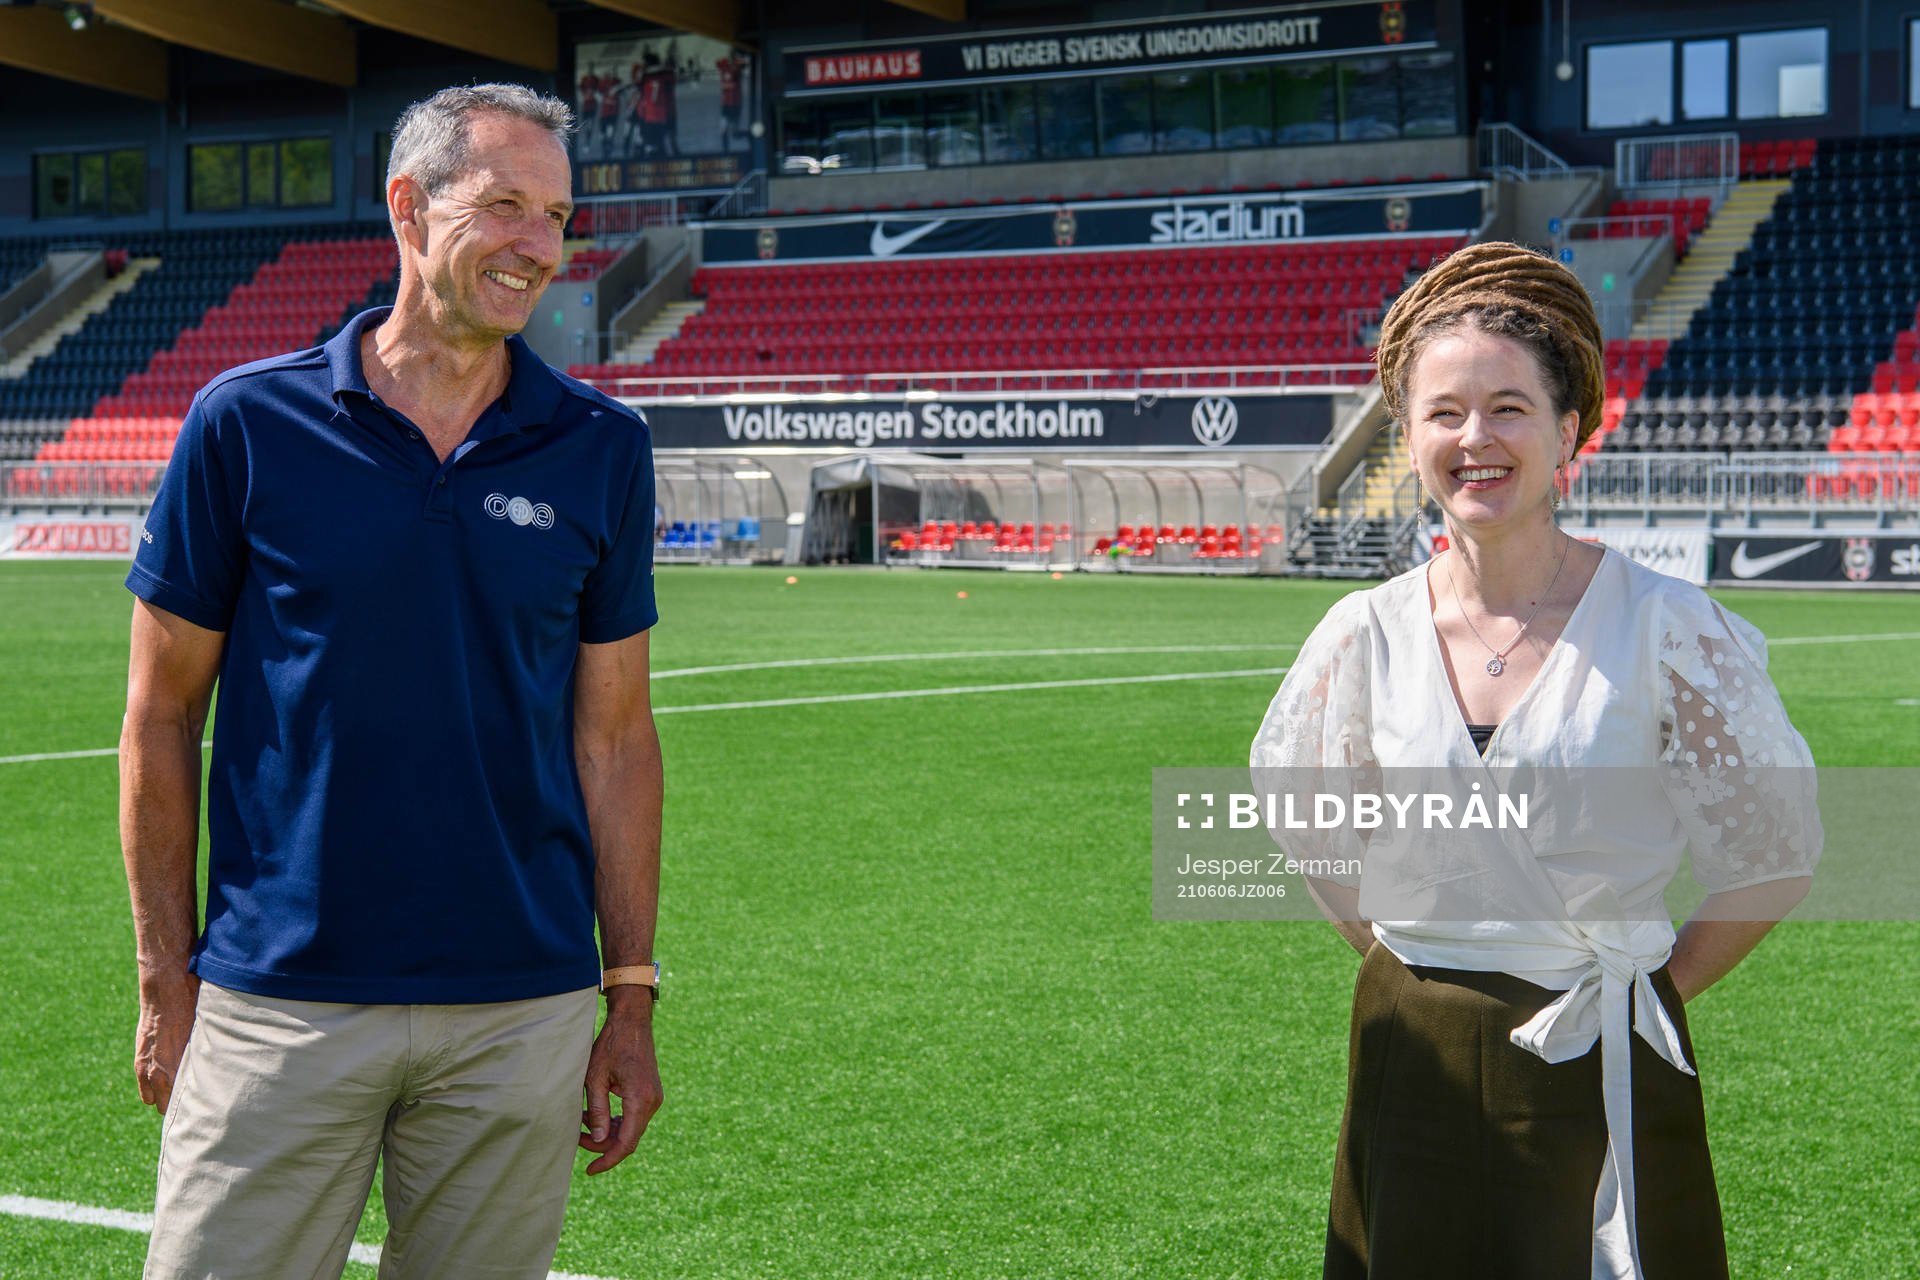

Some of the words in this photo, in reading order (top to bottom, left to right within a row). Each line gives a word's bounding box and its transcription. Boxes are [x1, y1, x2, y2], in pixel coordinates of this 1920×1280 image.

[961, 46, 983, 71] VI
[986, 39, 1060, 69] BYGGER
[1064, 33, 1144, 64] SVENSK
[1145, 17, 1321, 57] UNGDOMSIDROTT
[807, 53, 921, 83] BAUHAUS
[1150, 201, 1304, 243] stadium
[722, 404, 915, 447] Volkswagen
[920, 401, 1105, 439] Stockholm
